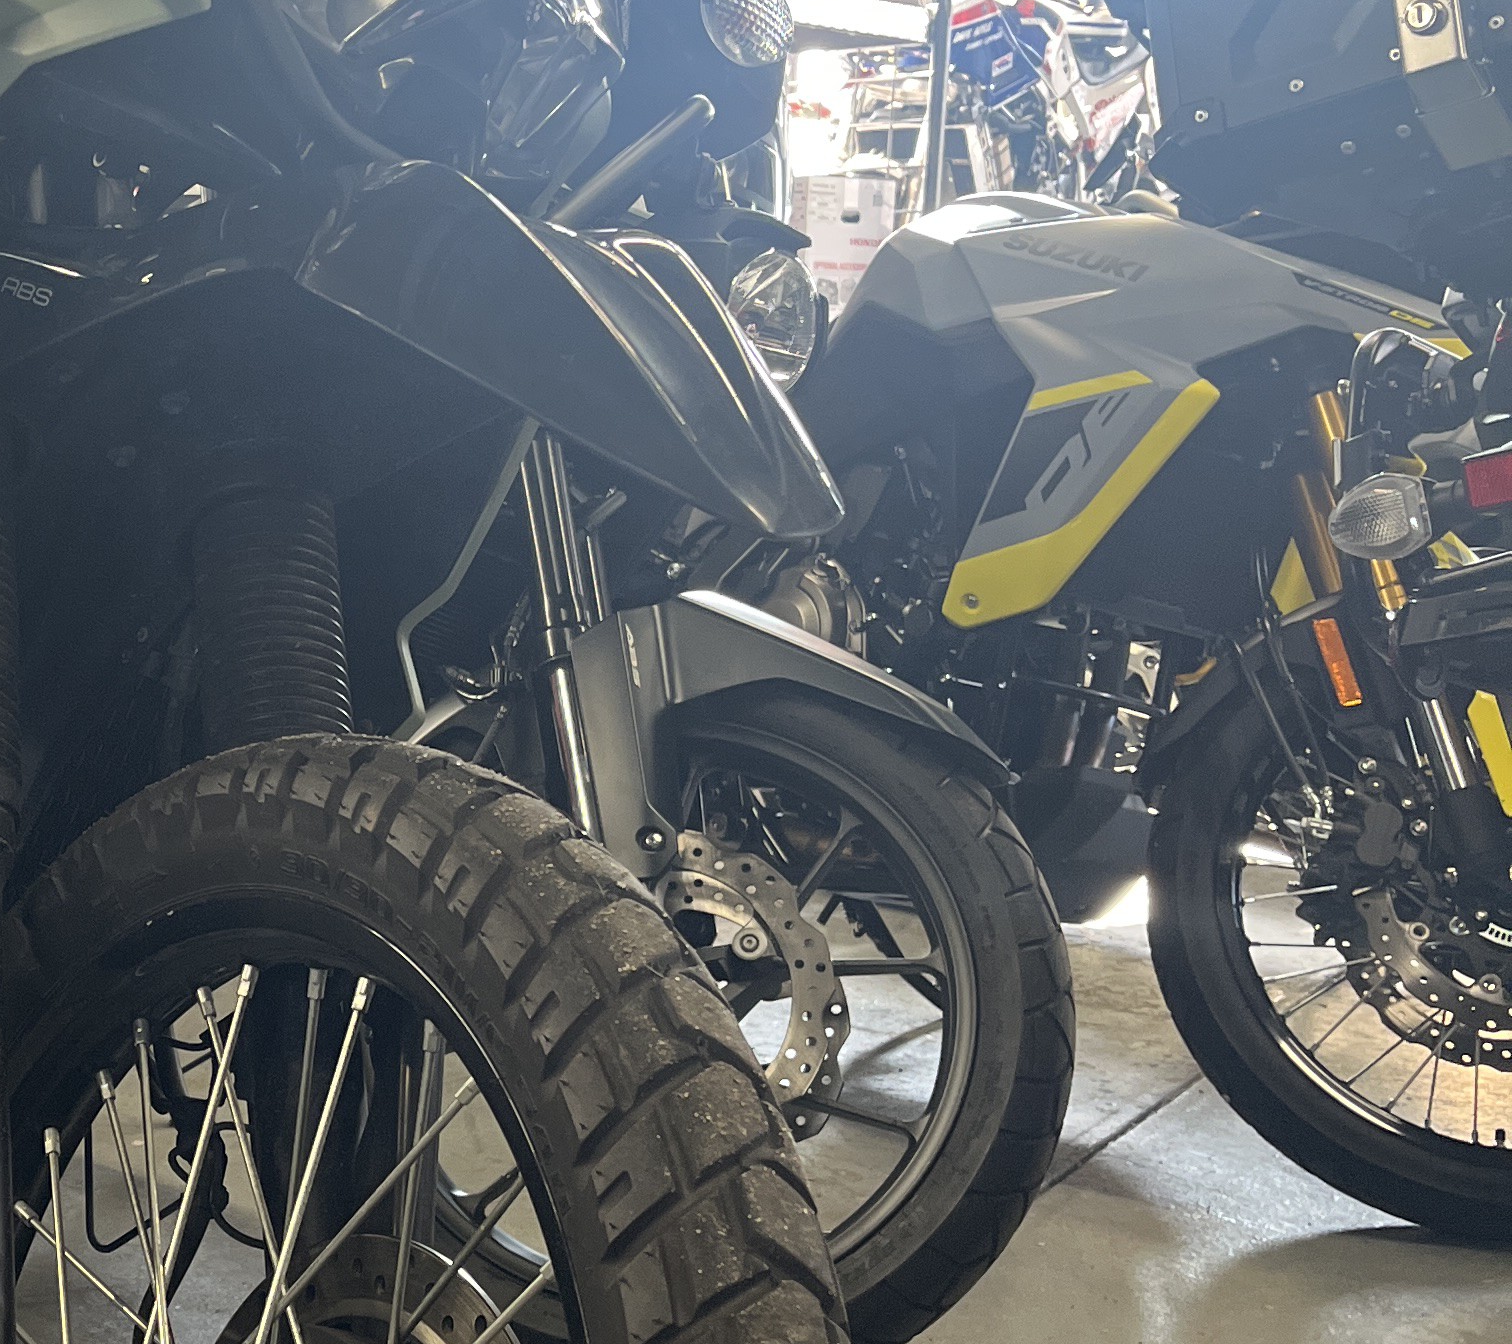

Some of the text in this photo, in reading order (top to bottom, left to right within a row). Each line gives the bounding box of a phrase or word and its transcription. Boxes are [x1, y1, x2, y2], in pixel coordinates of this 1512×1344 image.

[850, 238, 882, 248] HOND
[1002, 232, 1150, 283] SUZUKI
[0, 276, 53, 307] ABS
